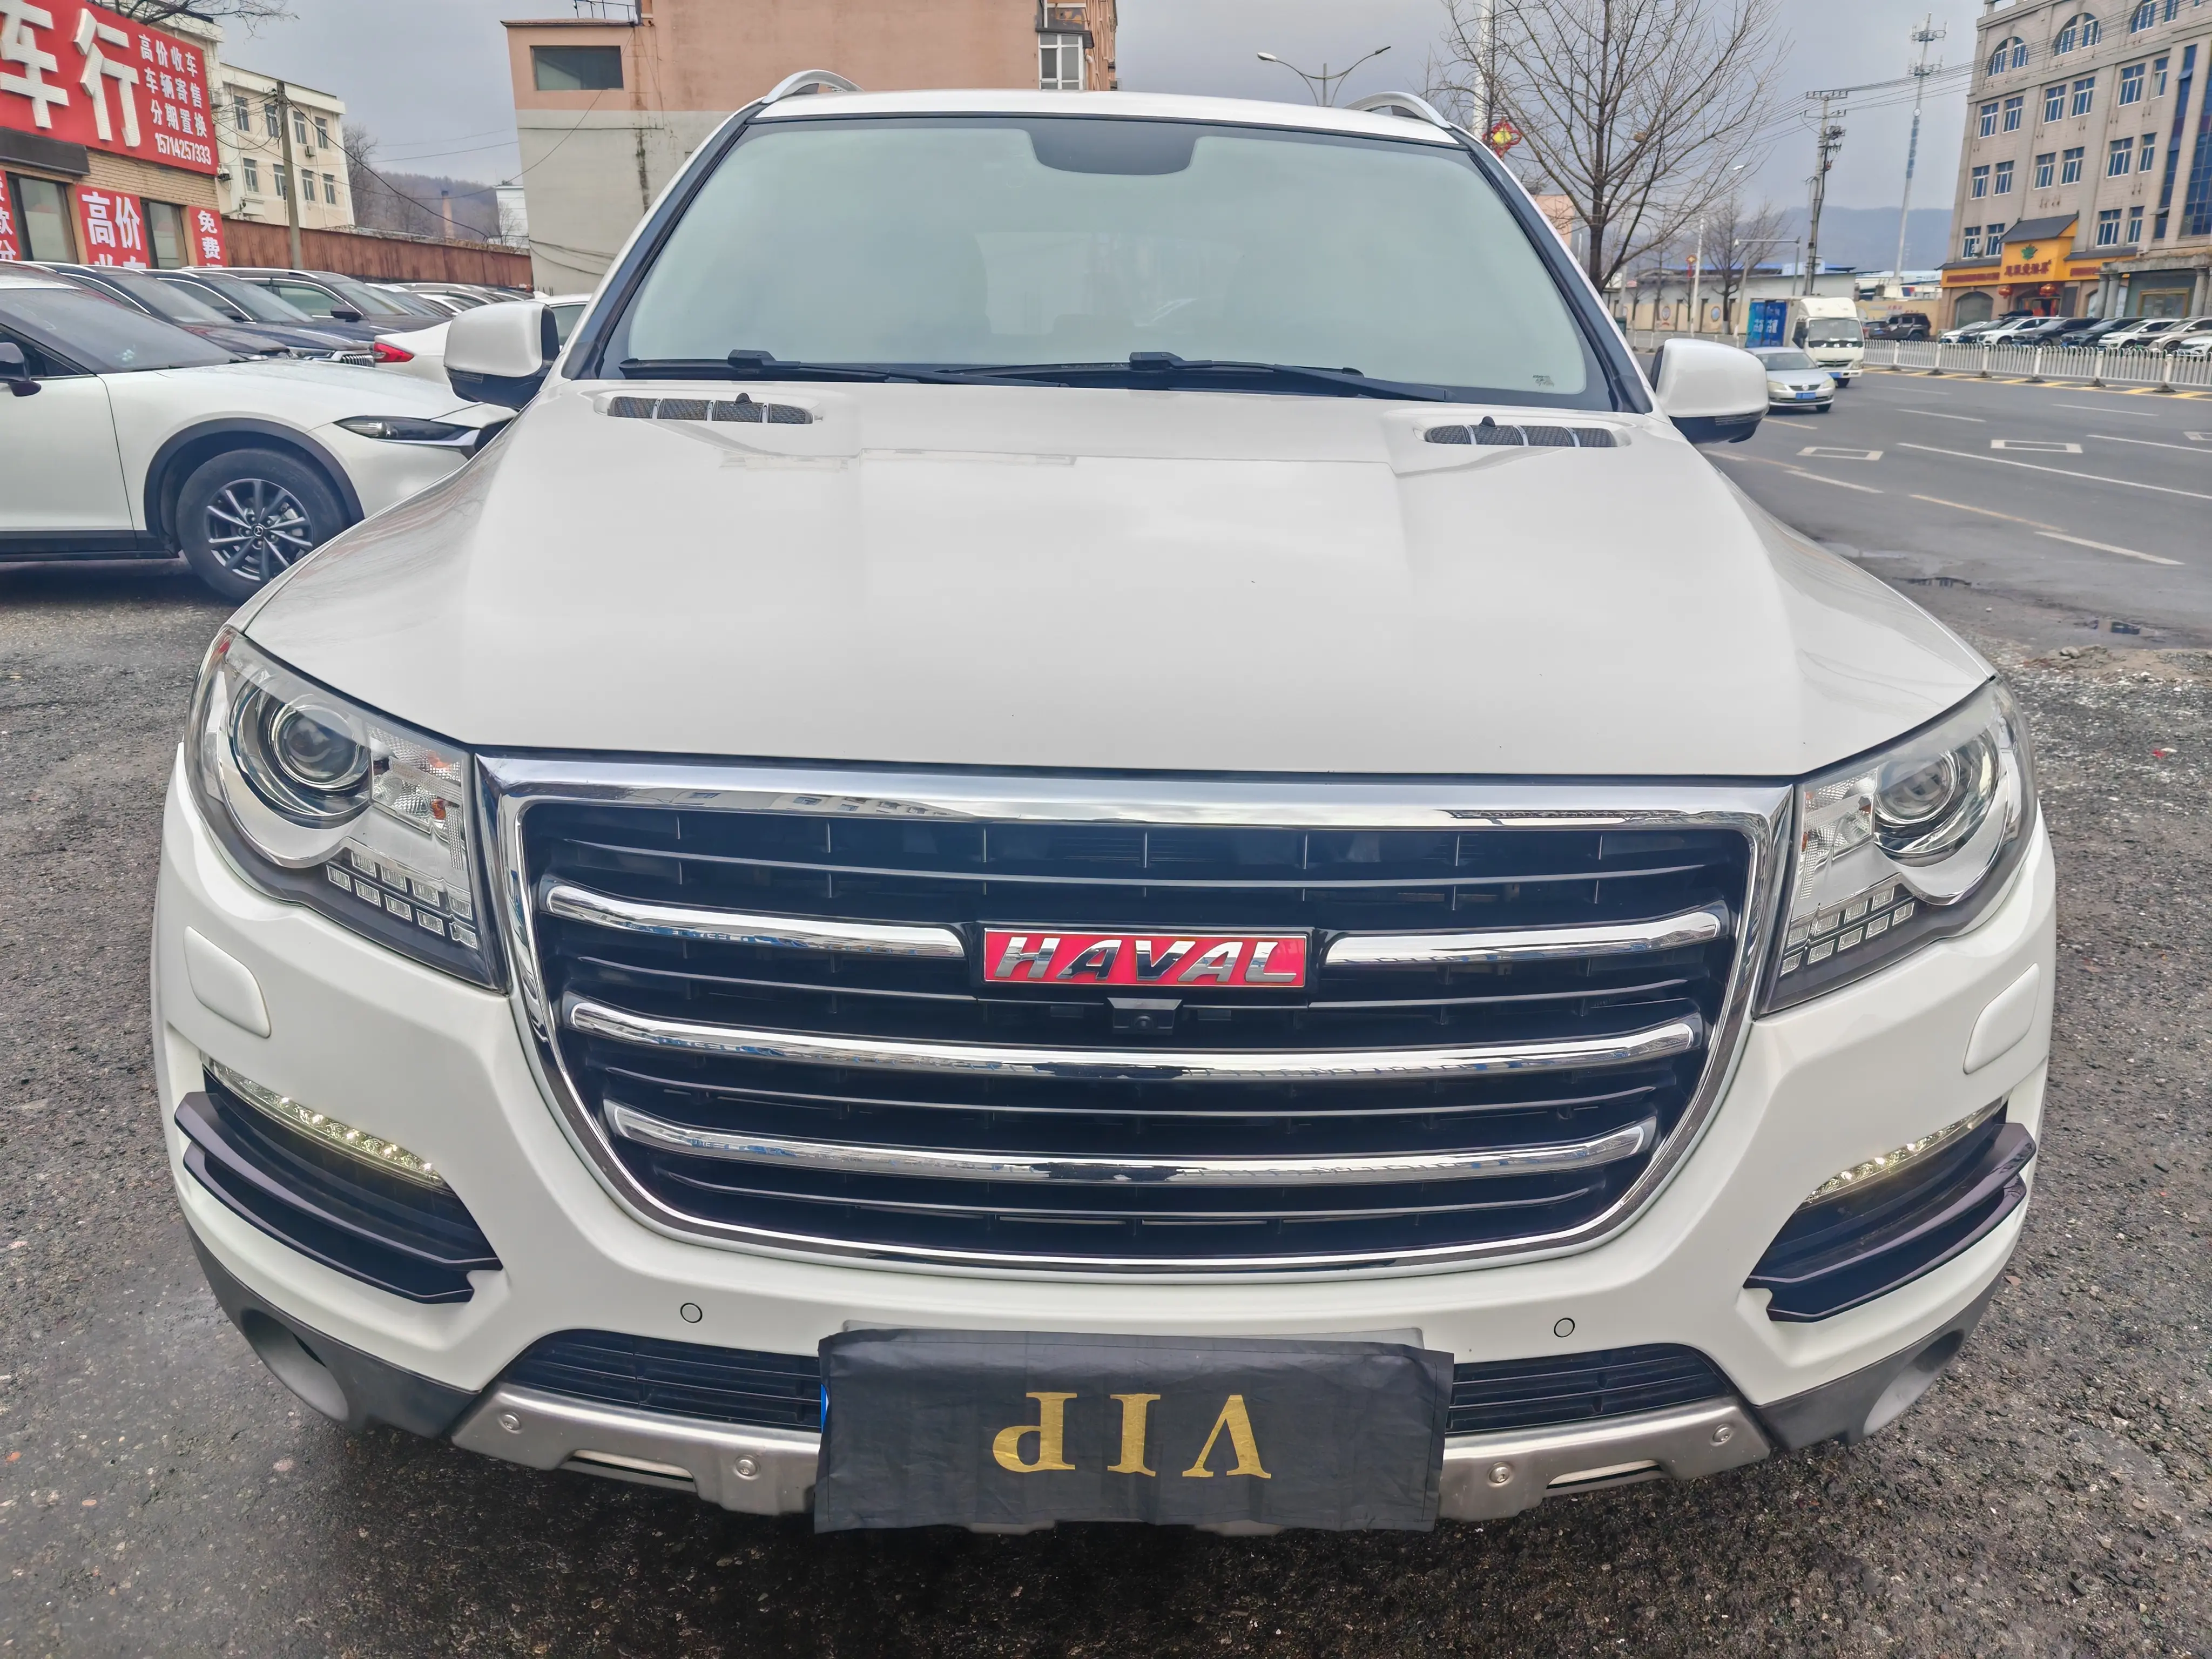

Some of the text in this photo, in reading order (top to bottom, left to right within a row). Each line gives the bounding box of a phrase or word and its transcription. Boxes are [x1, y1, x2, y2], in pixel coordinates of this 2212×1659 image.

[0, 0, 140, 147] 车行
[138, 34, 198, 77] 高价收车
[144, 67, 203, 109] 车辆寄售
[151, 99, 207, 138] 分期置换
[155, 133, 212, 165] 15714257333
[82, 191, 140, 251] 高价
[197, 210, 222, 267] 免费
[994, 937, 1297, 983] HAVAL
[992, 1391, 1272, 1479] VIP
